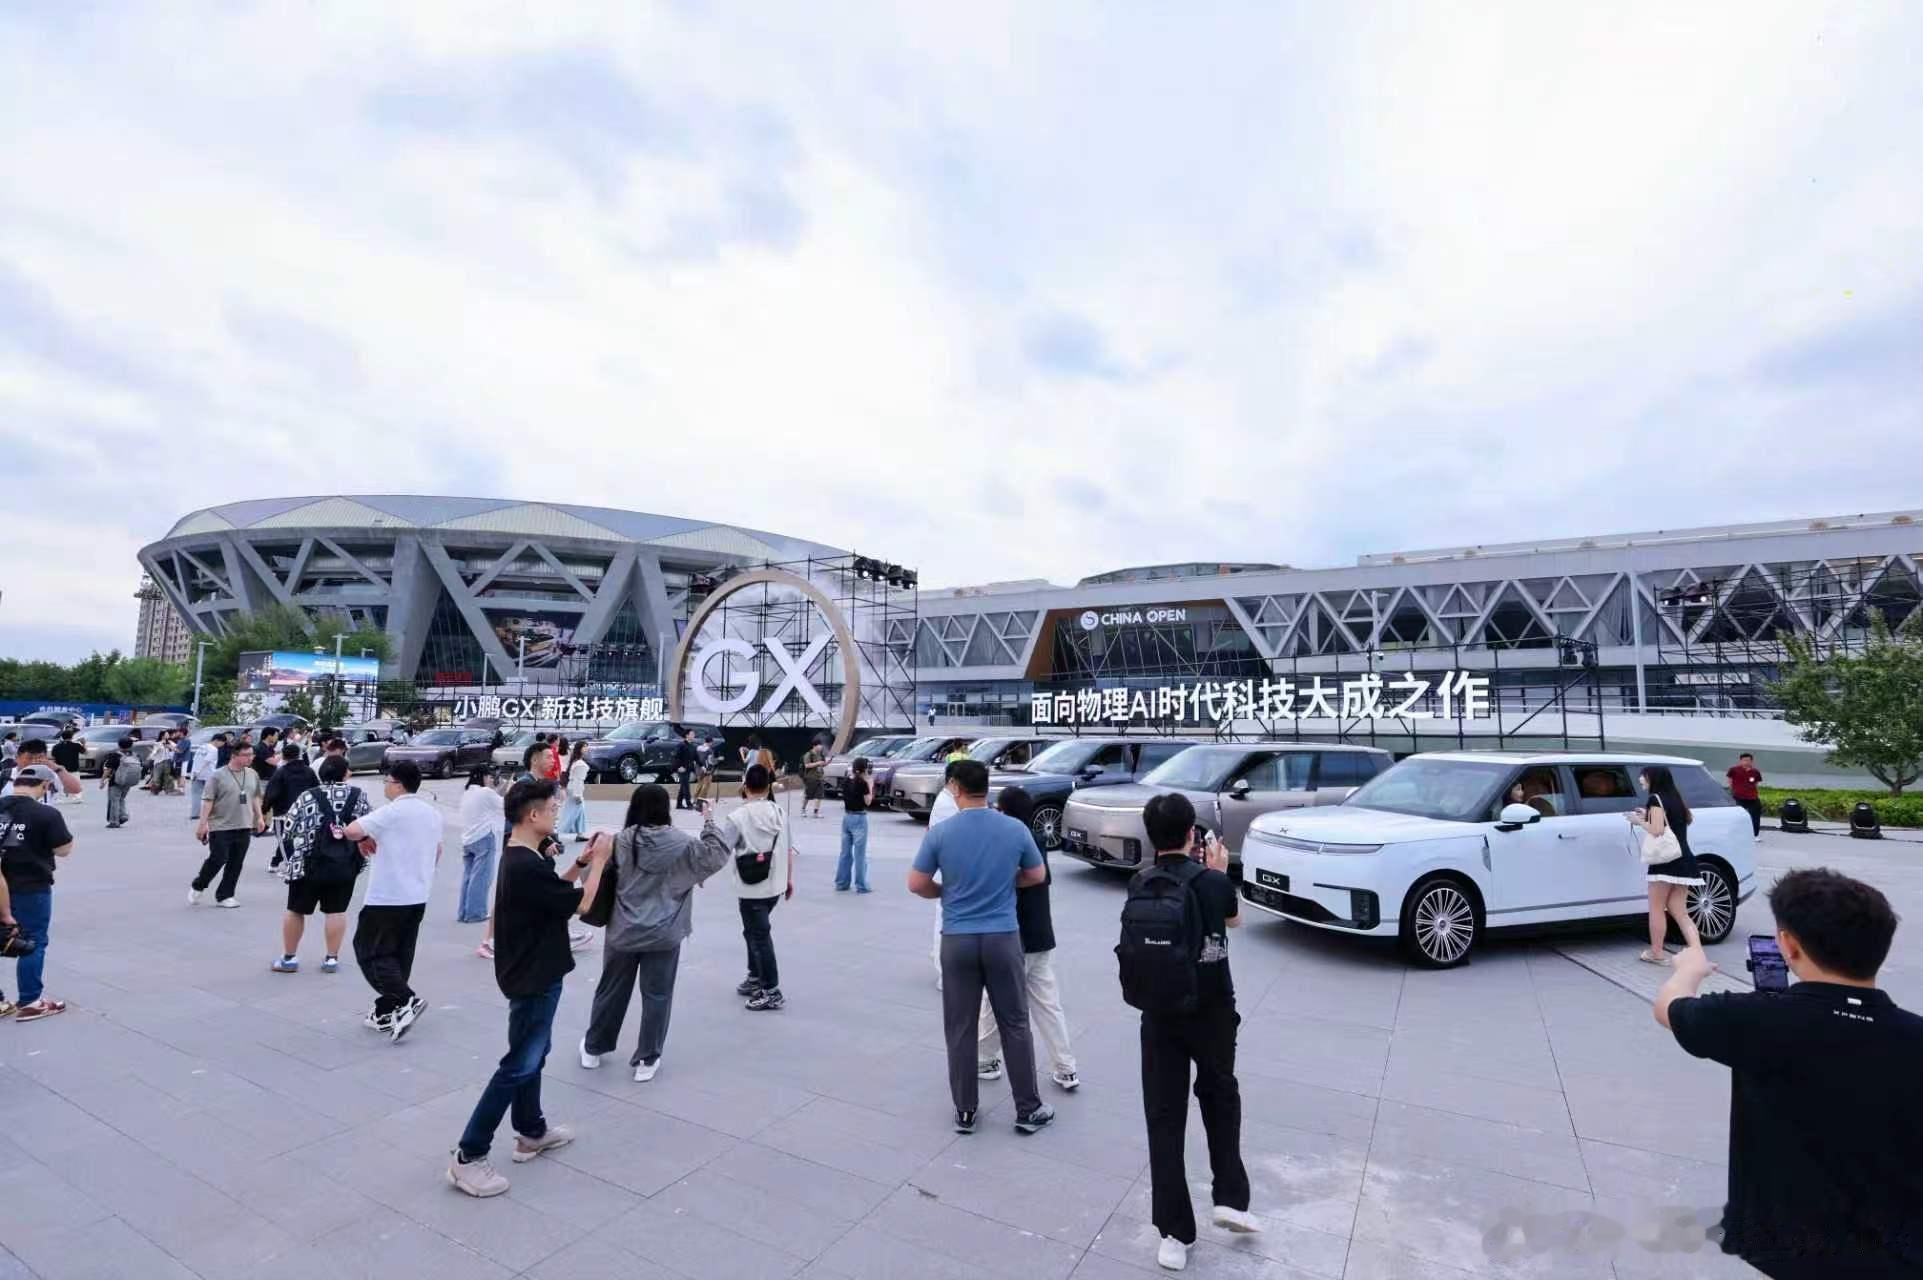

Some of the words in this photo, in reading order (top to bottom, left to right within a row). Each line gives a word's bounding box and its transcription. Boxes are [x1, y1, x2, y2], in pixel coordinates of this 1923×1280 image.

[1101, 611, 1143, 626] CHINA
[1146, 608, 1186, 623] OPEN
[692, 632, 835, 713] GX
[453, 694, 535, 720] 小鹏GX
[541, 695, 665, 721] 新科技旗舰
[1031, 670, 1490, 725] 面向物理AI时代科技大成之作
